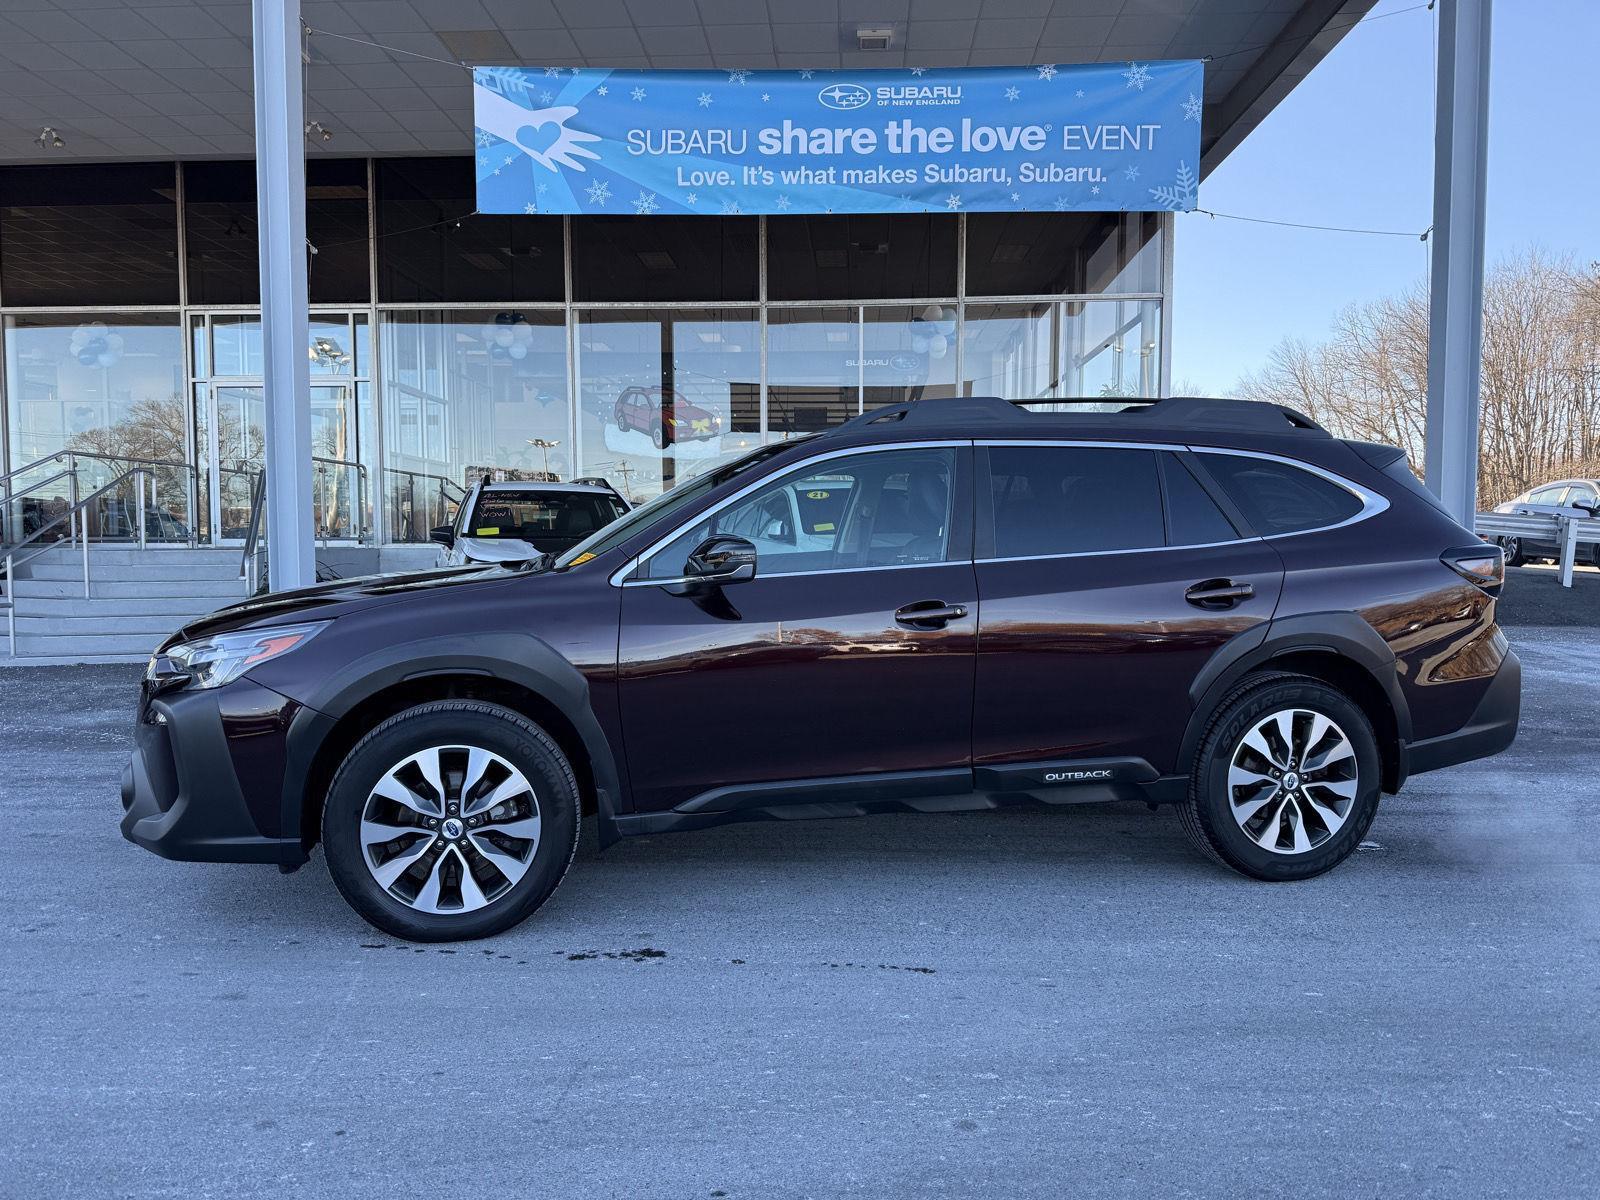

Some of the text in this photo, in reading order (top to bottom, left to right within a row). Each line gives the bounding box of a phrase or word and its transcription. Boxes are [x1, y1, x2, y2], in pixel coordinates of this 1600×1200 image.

[876, 86, 962, 99] SUBARU
[626, 128, 748, 156] SUBARU
[757, 119, 878, 156] share
[884, 118, 955, 154] the
[1062, 124, 1162, 151] EVENT
[676, 162, 1107, 187] Love. It's what makes Subaru, Subaru.
[1044, 769, 1112, 782] OUTBACK
